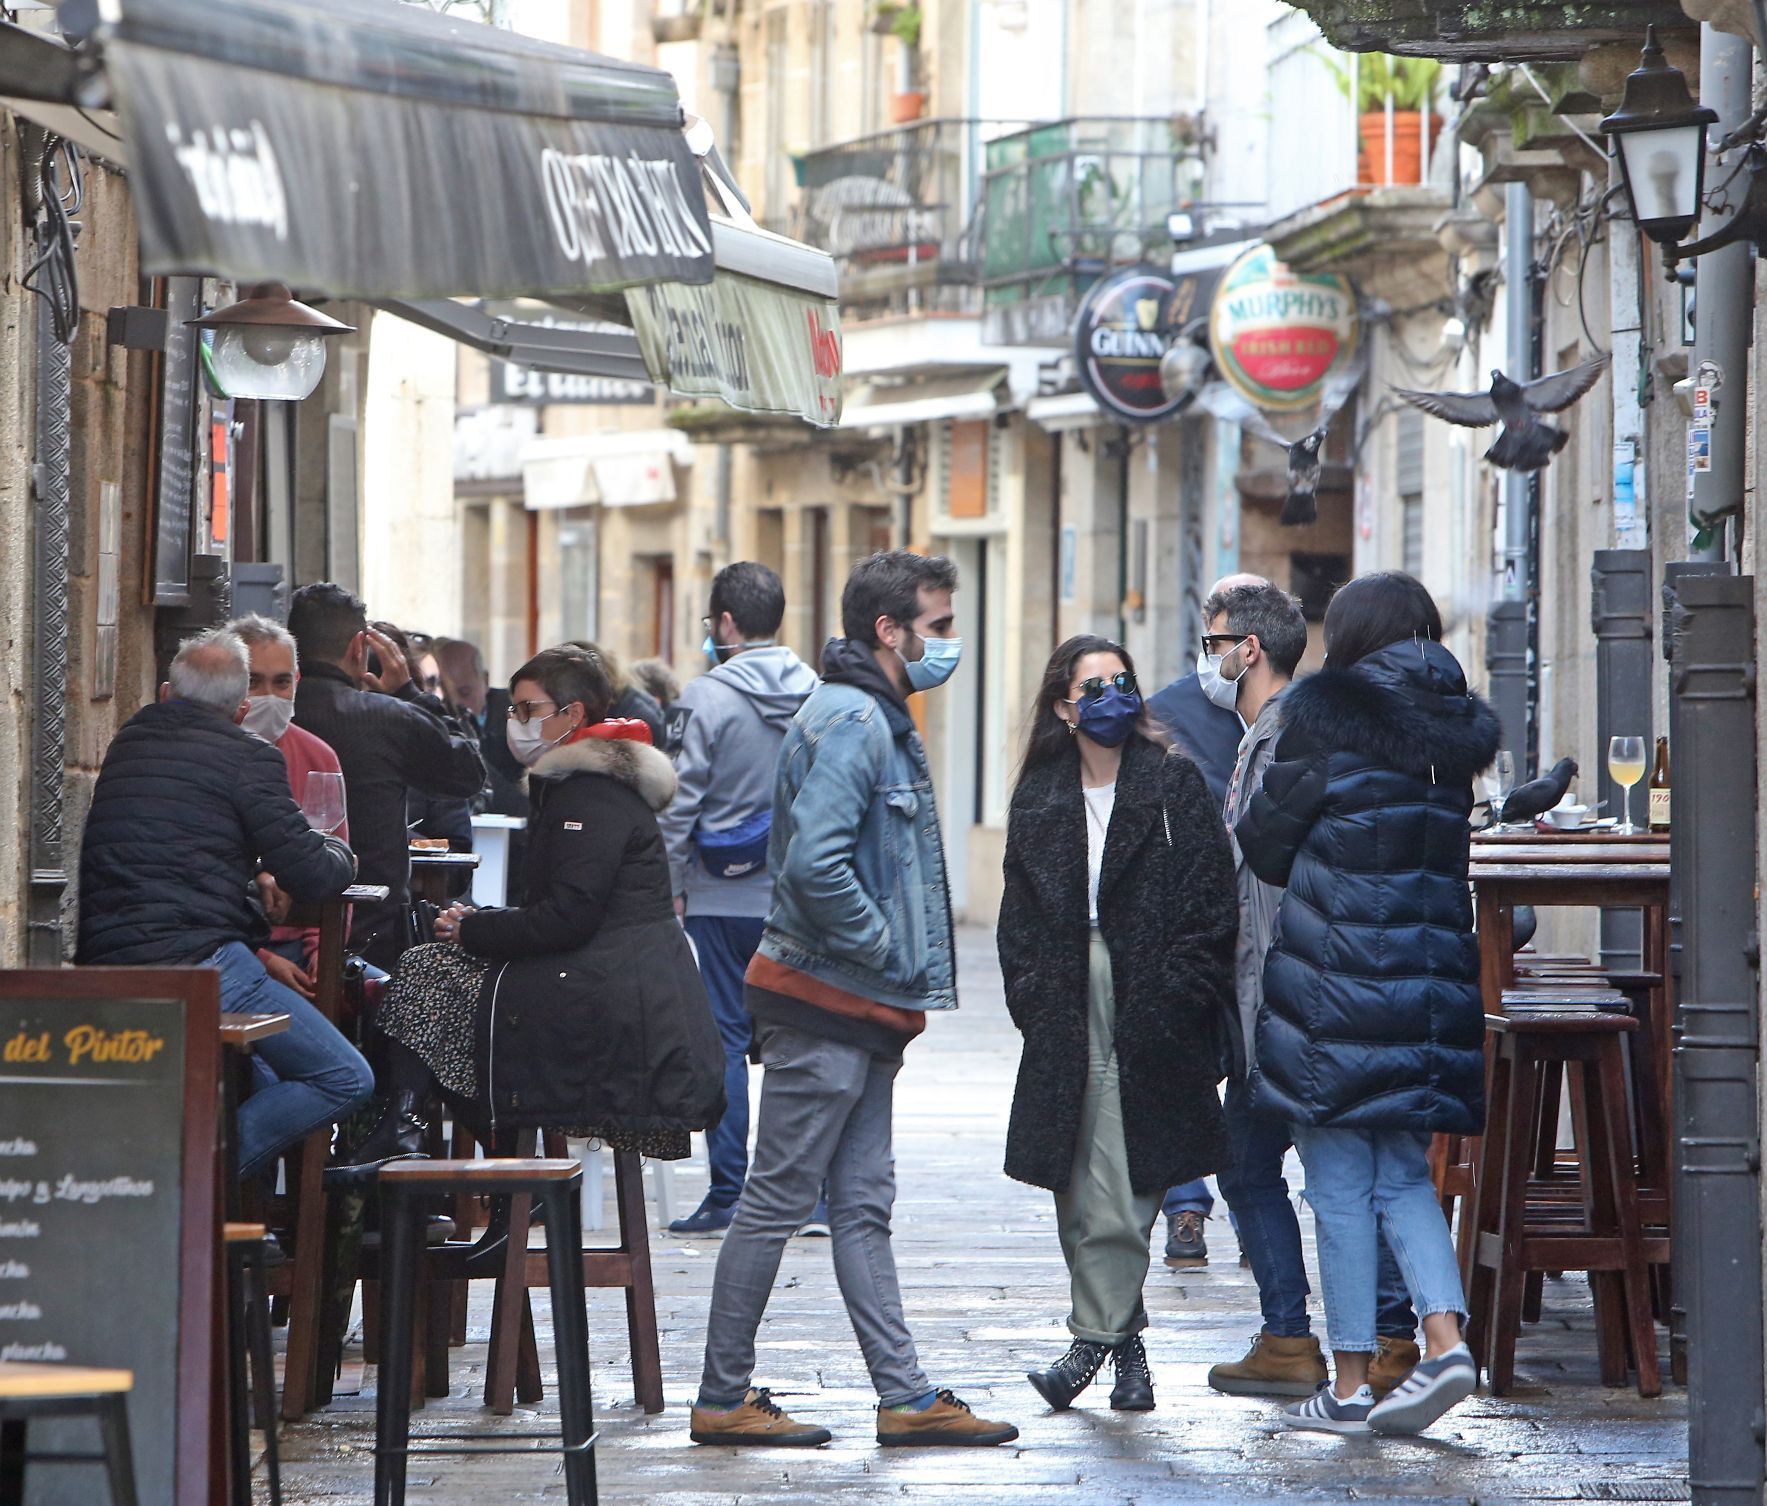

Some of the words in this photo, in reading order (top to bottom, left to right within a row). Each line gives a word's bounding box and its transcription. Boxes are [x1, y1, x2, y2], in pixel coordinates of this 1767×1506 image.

[1090, 326, 1168, 357] GUINN
[1651, 793, 1670, 804] 190
[3, 1031, 52, 1063] del
[63, 1023, 165, 1067] Pintor
